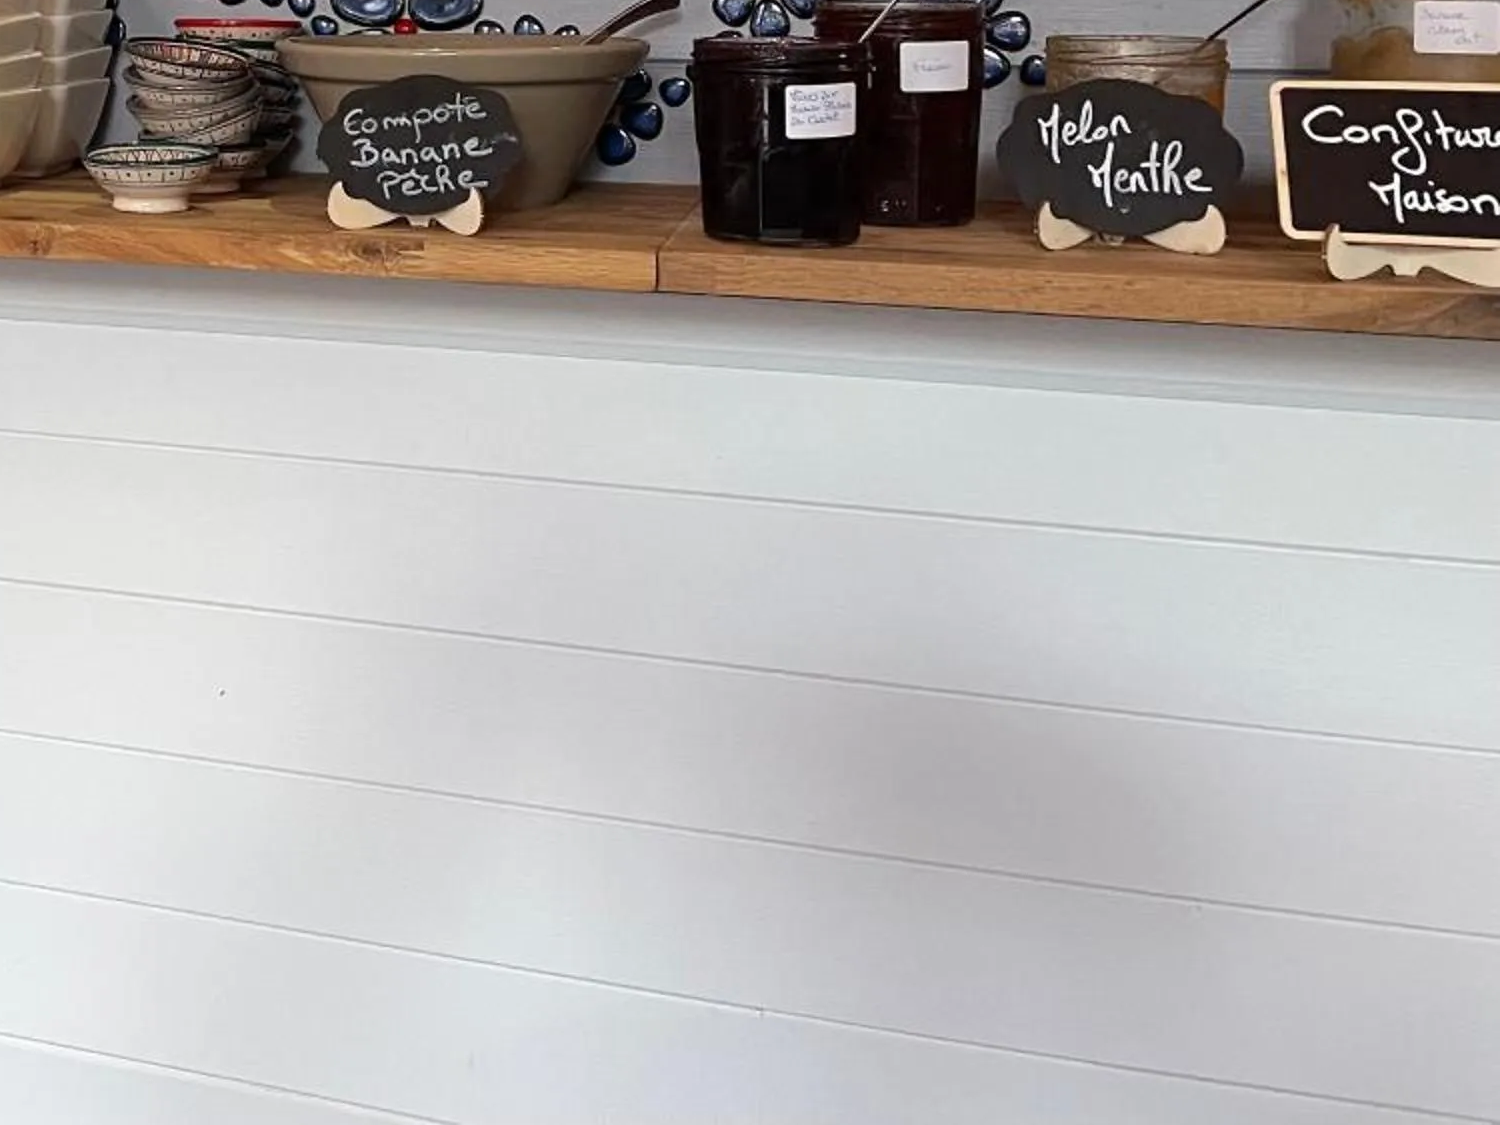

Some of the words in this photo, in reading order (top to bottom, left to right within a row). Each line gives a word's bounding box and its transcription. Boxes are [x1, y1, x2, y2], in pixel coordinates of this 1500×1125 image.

[343, 92, 488, 143] Compote
[1037, 99, 1132, 164] Melon
[350, 135, 494, 168] Banane
[1086, 140, 1214, 208] Menthe
[1367, 172, 1500, 224] Maison
